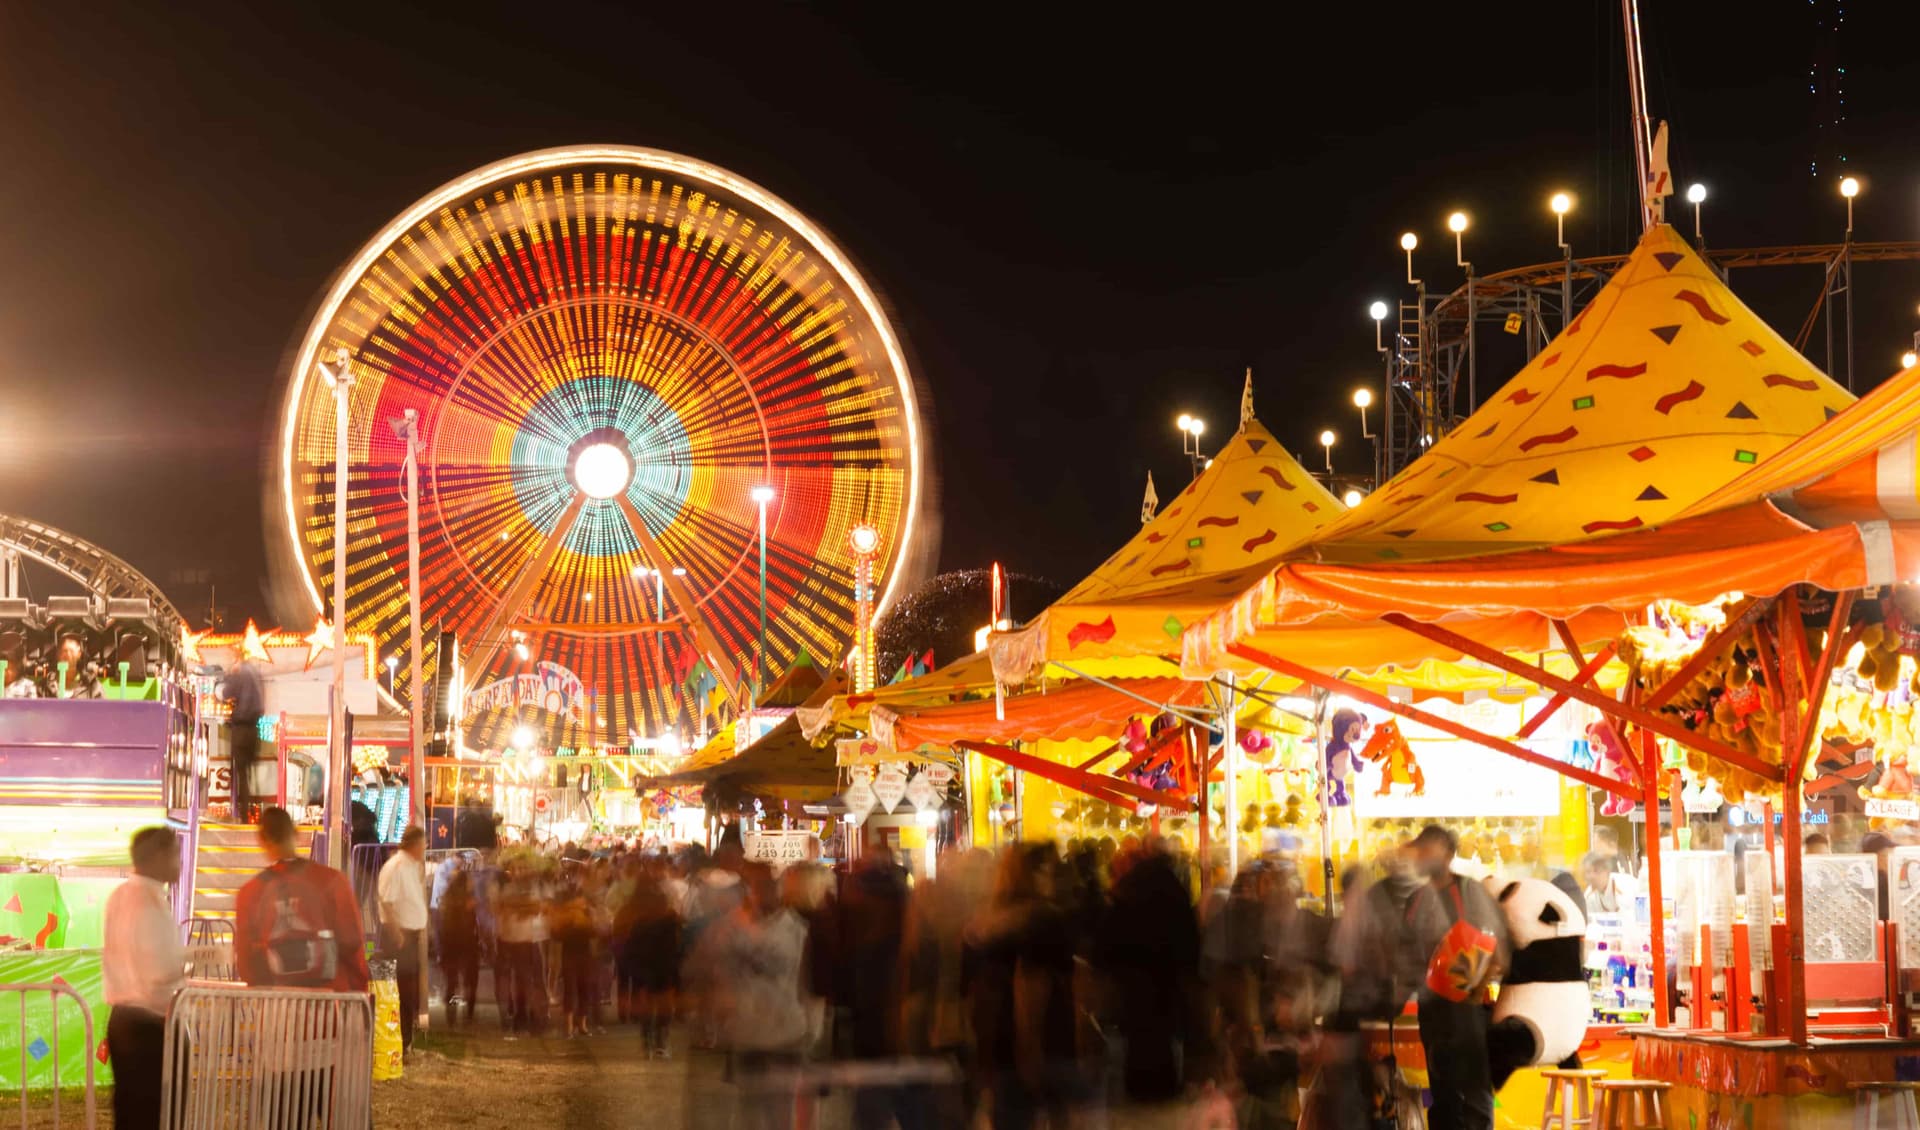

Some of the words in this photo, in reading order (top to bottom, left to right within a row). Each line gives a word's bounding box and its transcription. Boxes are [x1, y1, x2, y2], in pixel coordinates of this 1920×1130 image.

[518, 678, 541, 701] DAY
[1800, 808, 1830, 825] Cash
[755, 849, 777, 858] 149
